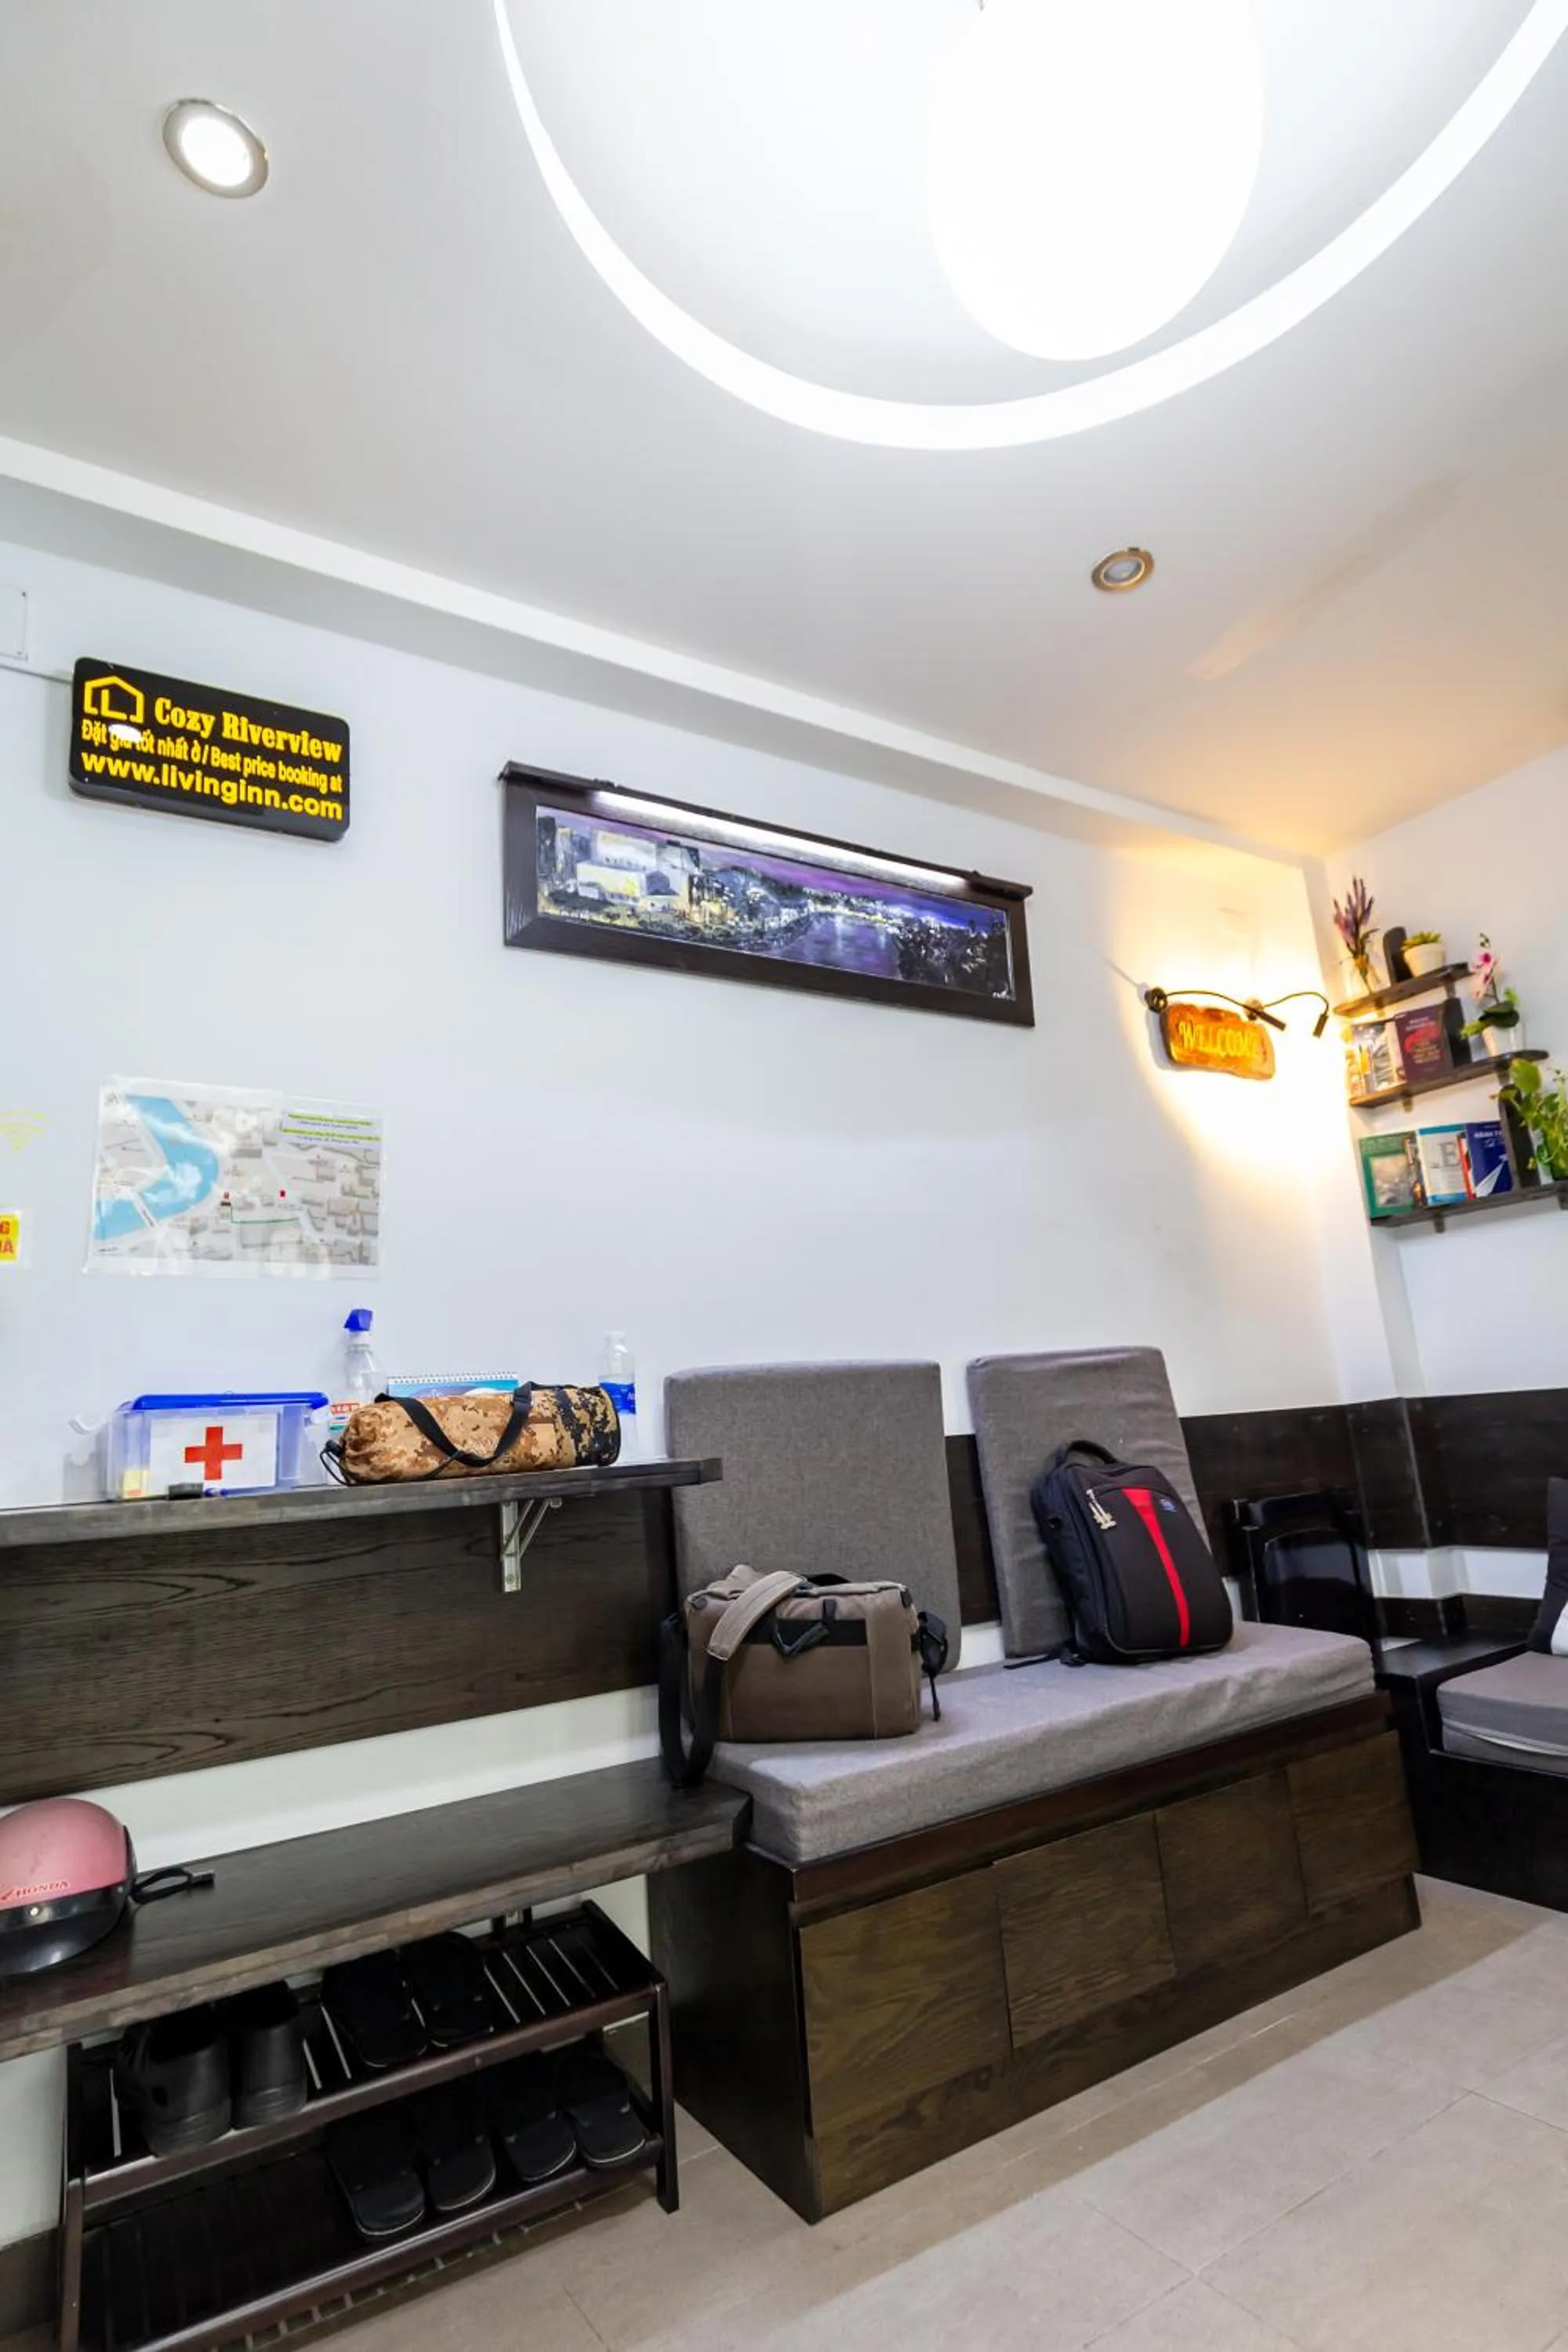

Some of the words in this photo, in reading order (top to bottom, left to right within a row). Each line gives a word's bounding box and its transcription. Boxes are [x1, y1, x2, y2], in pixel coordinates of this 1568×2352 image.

[82, 719, 107, 746] Đặt
[211, 746, 241, 772] Best
[243, 755, 276, 779] price
[278, 760, 328, 794] booking
[330, 774, 343, 793] at
[154, 697, 216, 739] Cozy
[222, 711, 343, 763] Riverview
[82, 752, 343, 821] www.livinginn.com
[16, 1880, 69, 1896] HONDA
